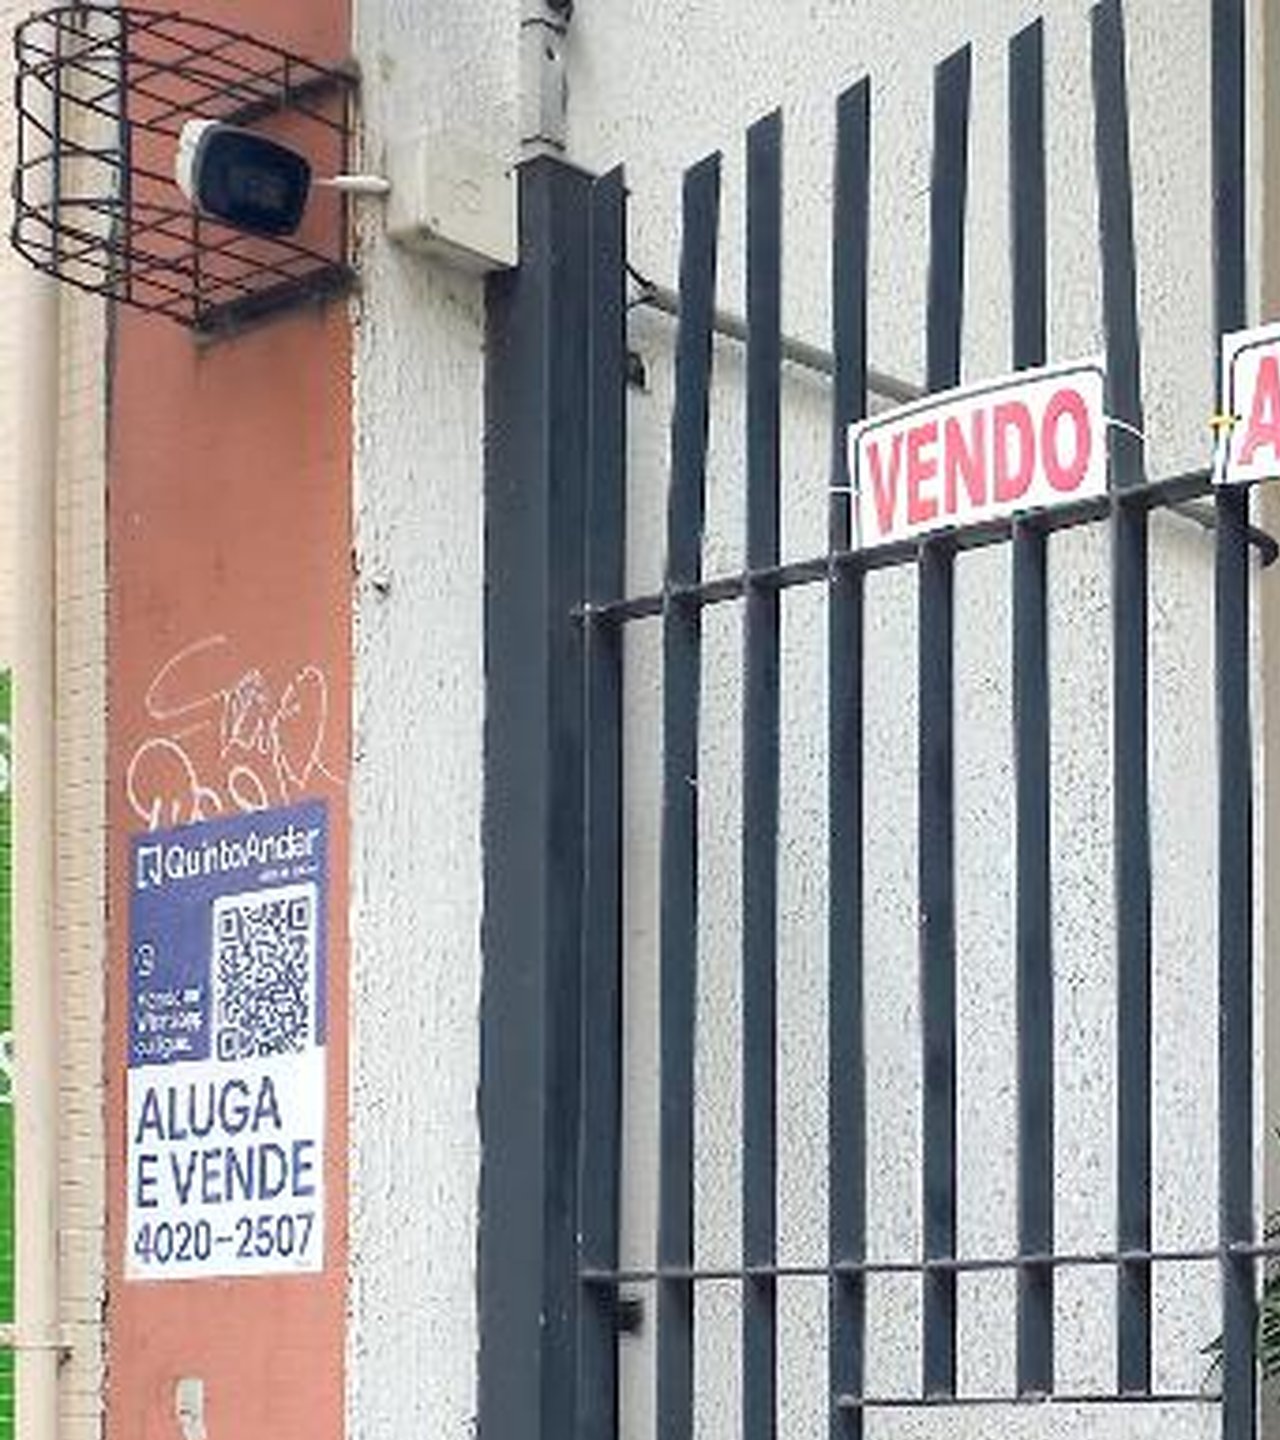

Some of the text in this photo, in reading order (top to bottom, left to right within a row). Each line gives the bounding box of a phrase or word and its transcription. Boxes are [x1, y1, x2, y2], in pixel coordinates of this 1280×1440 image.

[866, 387, 1092, 537] VENDO
[164, 824, 321, 880] QuintoAndar
[134, 1075, 282, 1144] ALUGA
[137, 1139, 316, 1208] E VENDE
[133, 1211, 316, 1265] 4020-2507
